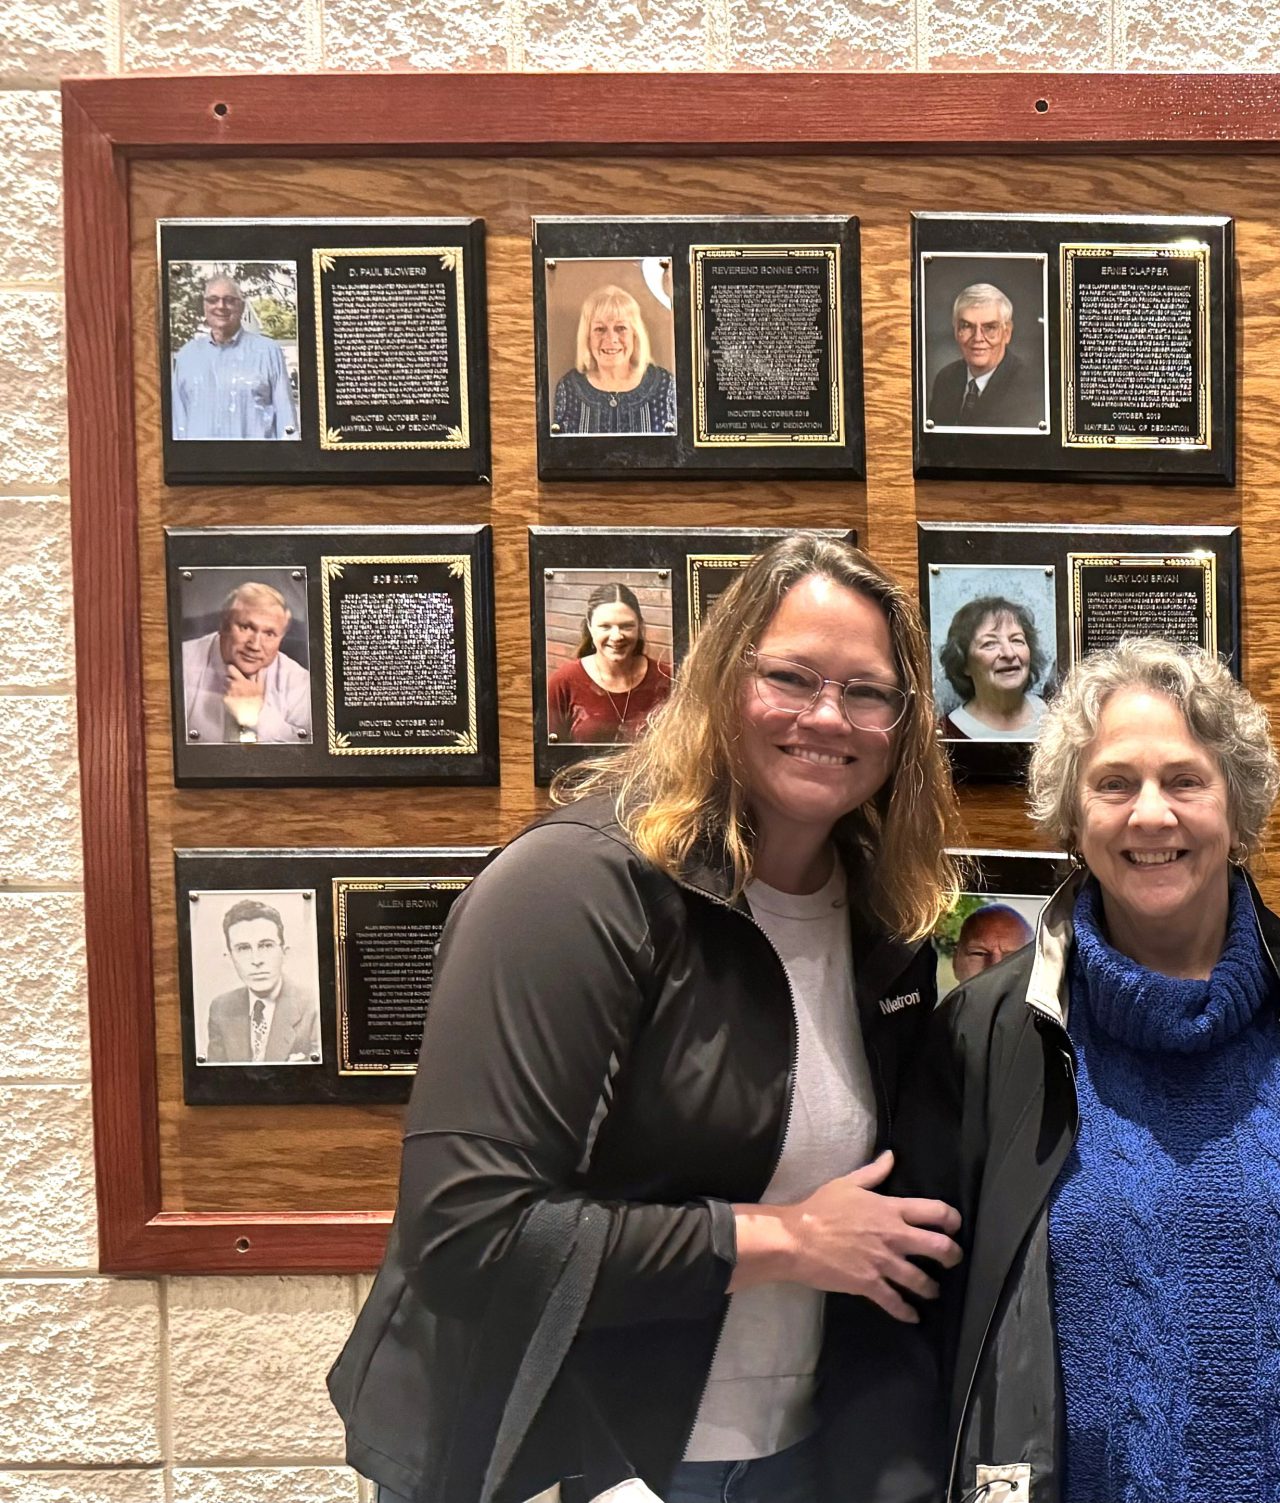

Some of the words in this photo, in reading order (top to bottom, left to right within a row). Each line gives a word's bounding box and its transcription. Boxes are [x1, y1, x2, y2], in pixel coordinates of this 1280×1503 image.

[349, 268, 358, 277] D.
[360, 267, 382, 276] PAUL
[384, 267, 427, 276] BLOWERS
[712, 266, 758, 274] REVEREND
[760, 266, 793, 274] BONNIE
[795, 266, 819, 274] ORTH
[1101, 266, 1127, 276] ERNIE
[1129, 267, 1169, 276] CLAPPER
[372, 575, 392, 584] BOB
[394, 574, 419, 584] SUITS
[1105, 574, 1130, 583] MARY
[1131, 574, 1148, 583] LOU
[1150, 574, 1179, 583] BRYAN
[378, 900, 404, 908] ALLEN
[406, 900, 439, 908] BROWN
[414, 1048, 420, 1056] O
